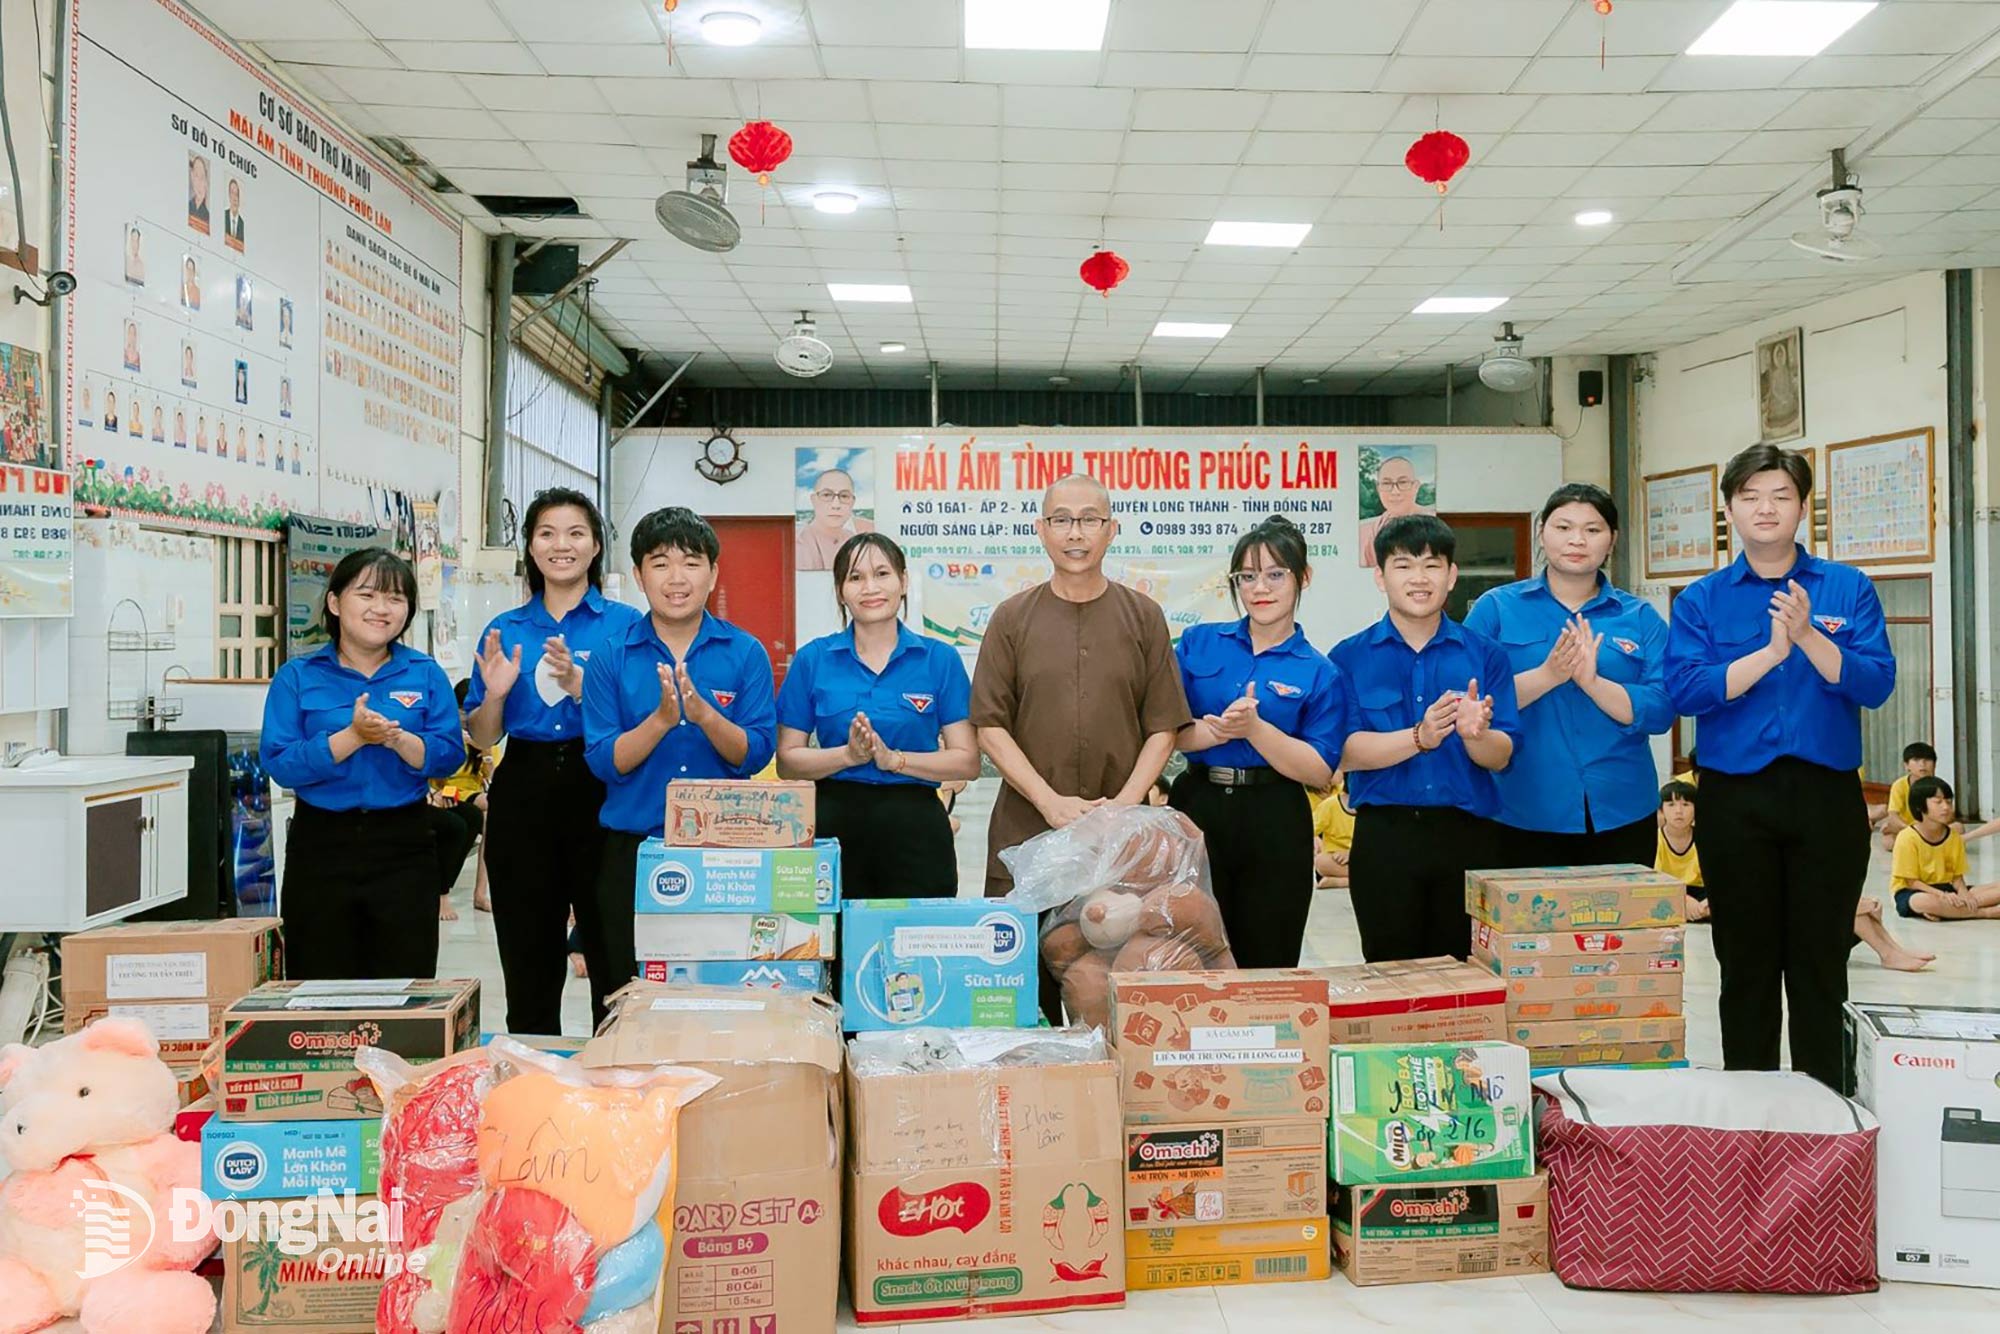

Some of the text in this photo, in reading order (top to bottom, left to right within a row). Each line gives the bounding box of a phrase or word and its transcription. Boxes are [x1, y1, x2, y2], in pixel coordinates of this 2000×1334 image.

[171, 113, 188, 136] SƠ
[230, 108, 253, 140] MÁI
[278, 141, 304, 175] TÌNH
[306, 162, 346, 203] THƯƠNG
[896, 443, 947, 491] MÁI
[957, 436, 1000, 491] ẤM
[1083, 447, 1190, 490] THƯƠNG
[1200, 442, 1270, 490] PHÚC
[1281, 442, 1337, 490] LÂM
[1152, 501, 1185, 513] LONG
[1311, 500, 1332, 512] NAI
[900, 521, 938, 536] NGƯỜI
[1156, 523, 1186, 535] 0989
[1190, 523, 1212, 535] 393
[1216, 523, 1238, 535] 874
[1310, 522, 1332, 534] 287
[658, 876, 685, 886] DUTCH
[706, 870, 736, 882] Mạnh
[662, 883, 682, 891] LADY
[706, 882, 756, 891] Lớn Khôn
[964, 974, 1024, 987] Sữa Tươi
[288, 1030, 369, 1050] Omachi
[1893, 1053, 1956, 1069] Canon
[1139, 1140, 1209, 1160] Omachi
[1392, 1124, 1404, 1162] MILO
[284, 1145, 346, 1162] Mạnh Mẽ
[226, 1160, 256, 1168] DUTCH
[230, 1166, 252, 1175] LADY
[284, 1160, 346, 1173] Lớn Khôn
[282, 1174, 348, 1188] Mỗi Ngày
[1149, 1172, 1168, 1181] TRỘN
[1190, 1170, 1210, 1178] TRỘN
[1390, 1197, 1459, 1218] Omachi
[673, 1198, 824, 1233] OARD SET A4
[698, 1236, 754, 1254] Bảng Bộ
[877, 1249, 1016, 1272] khác nhau, cay đắng
[1906, 1254, 1920, 1262] 057
[732, 1266, 757, 1277] B-06
[726, 1282, 742, 1292] 80
[744, 1280, 762, 1291] Cái
[881, 1281, 922, 1296] Snack
